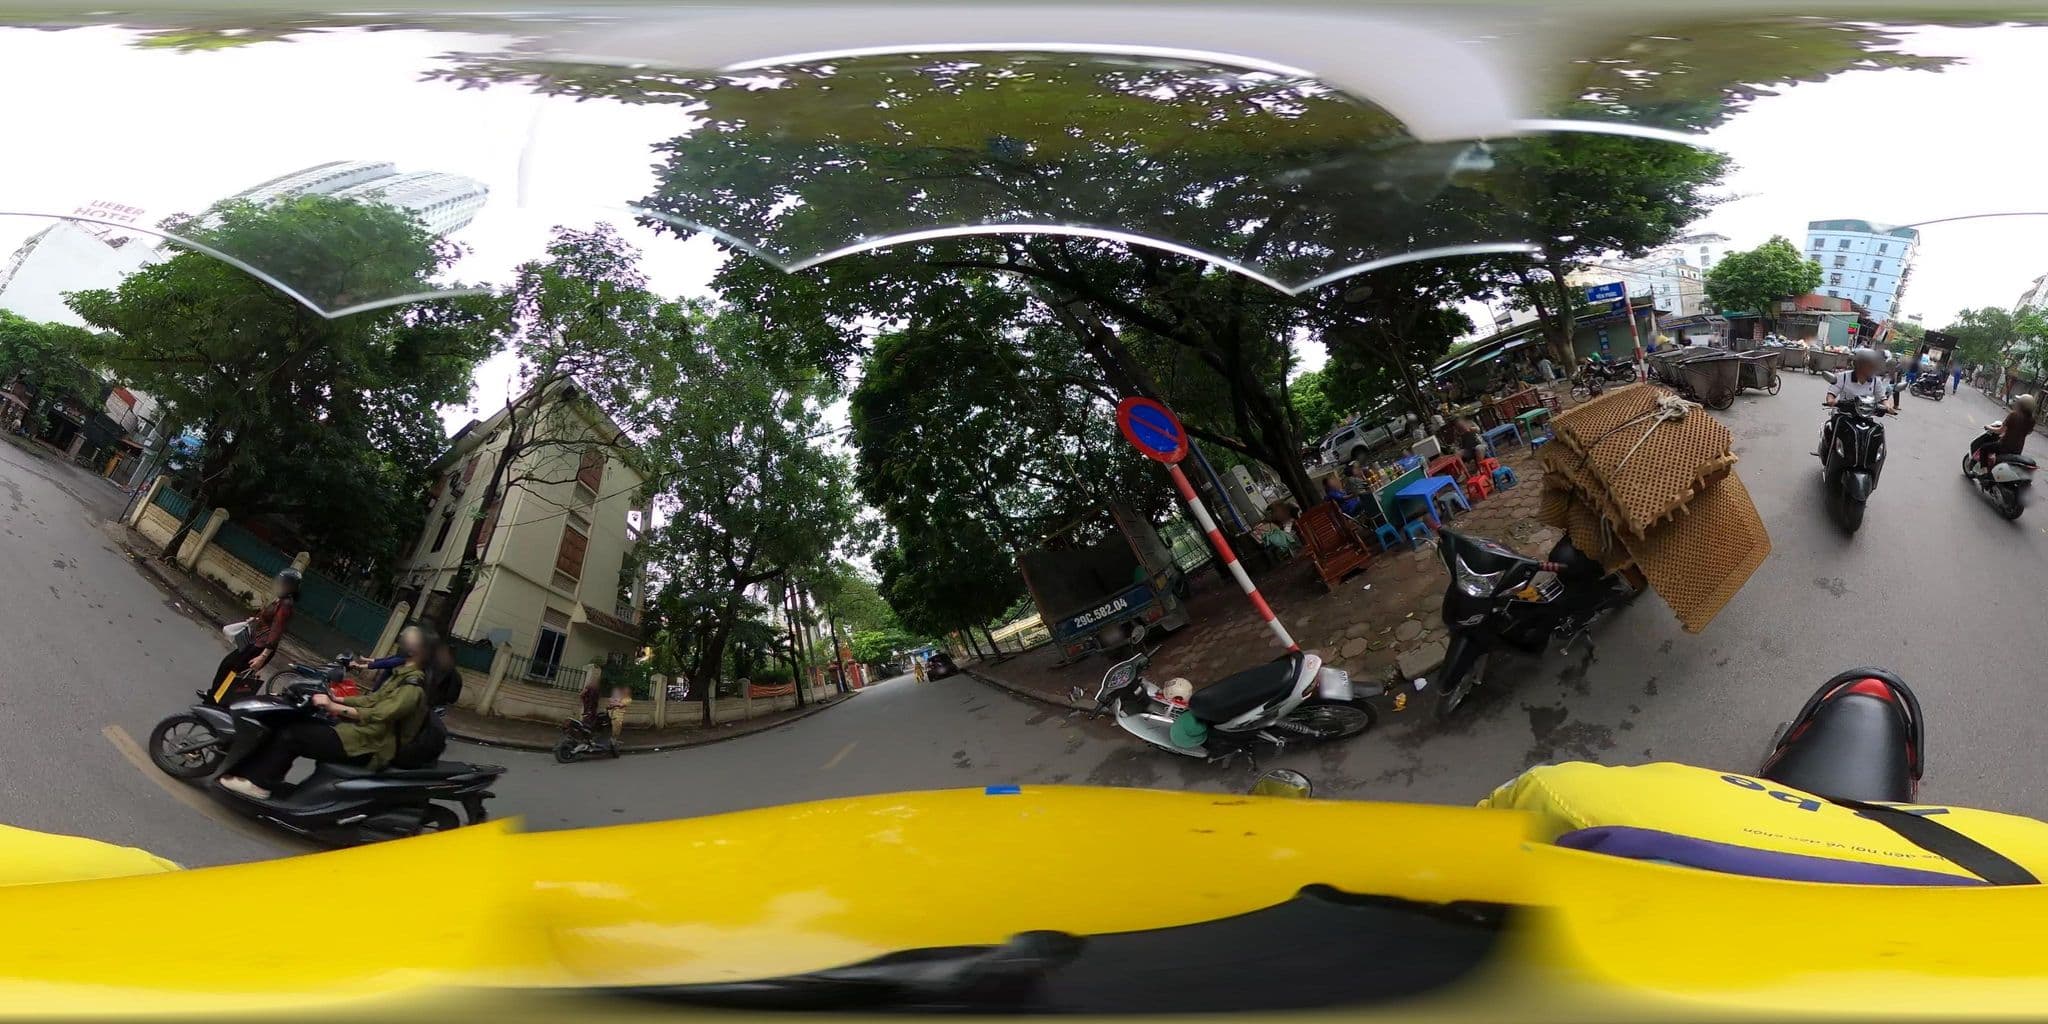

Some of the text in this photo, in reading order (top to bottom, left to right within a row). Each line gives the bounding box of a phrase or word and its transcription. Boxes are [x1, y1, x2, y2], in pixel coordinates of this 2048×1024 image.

[73, 207, 136, 223] HOTEL
[91, 199, 145, 215] LIEBER
[1074, 598, 1128, 628] 29C.582.04
